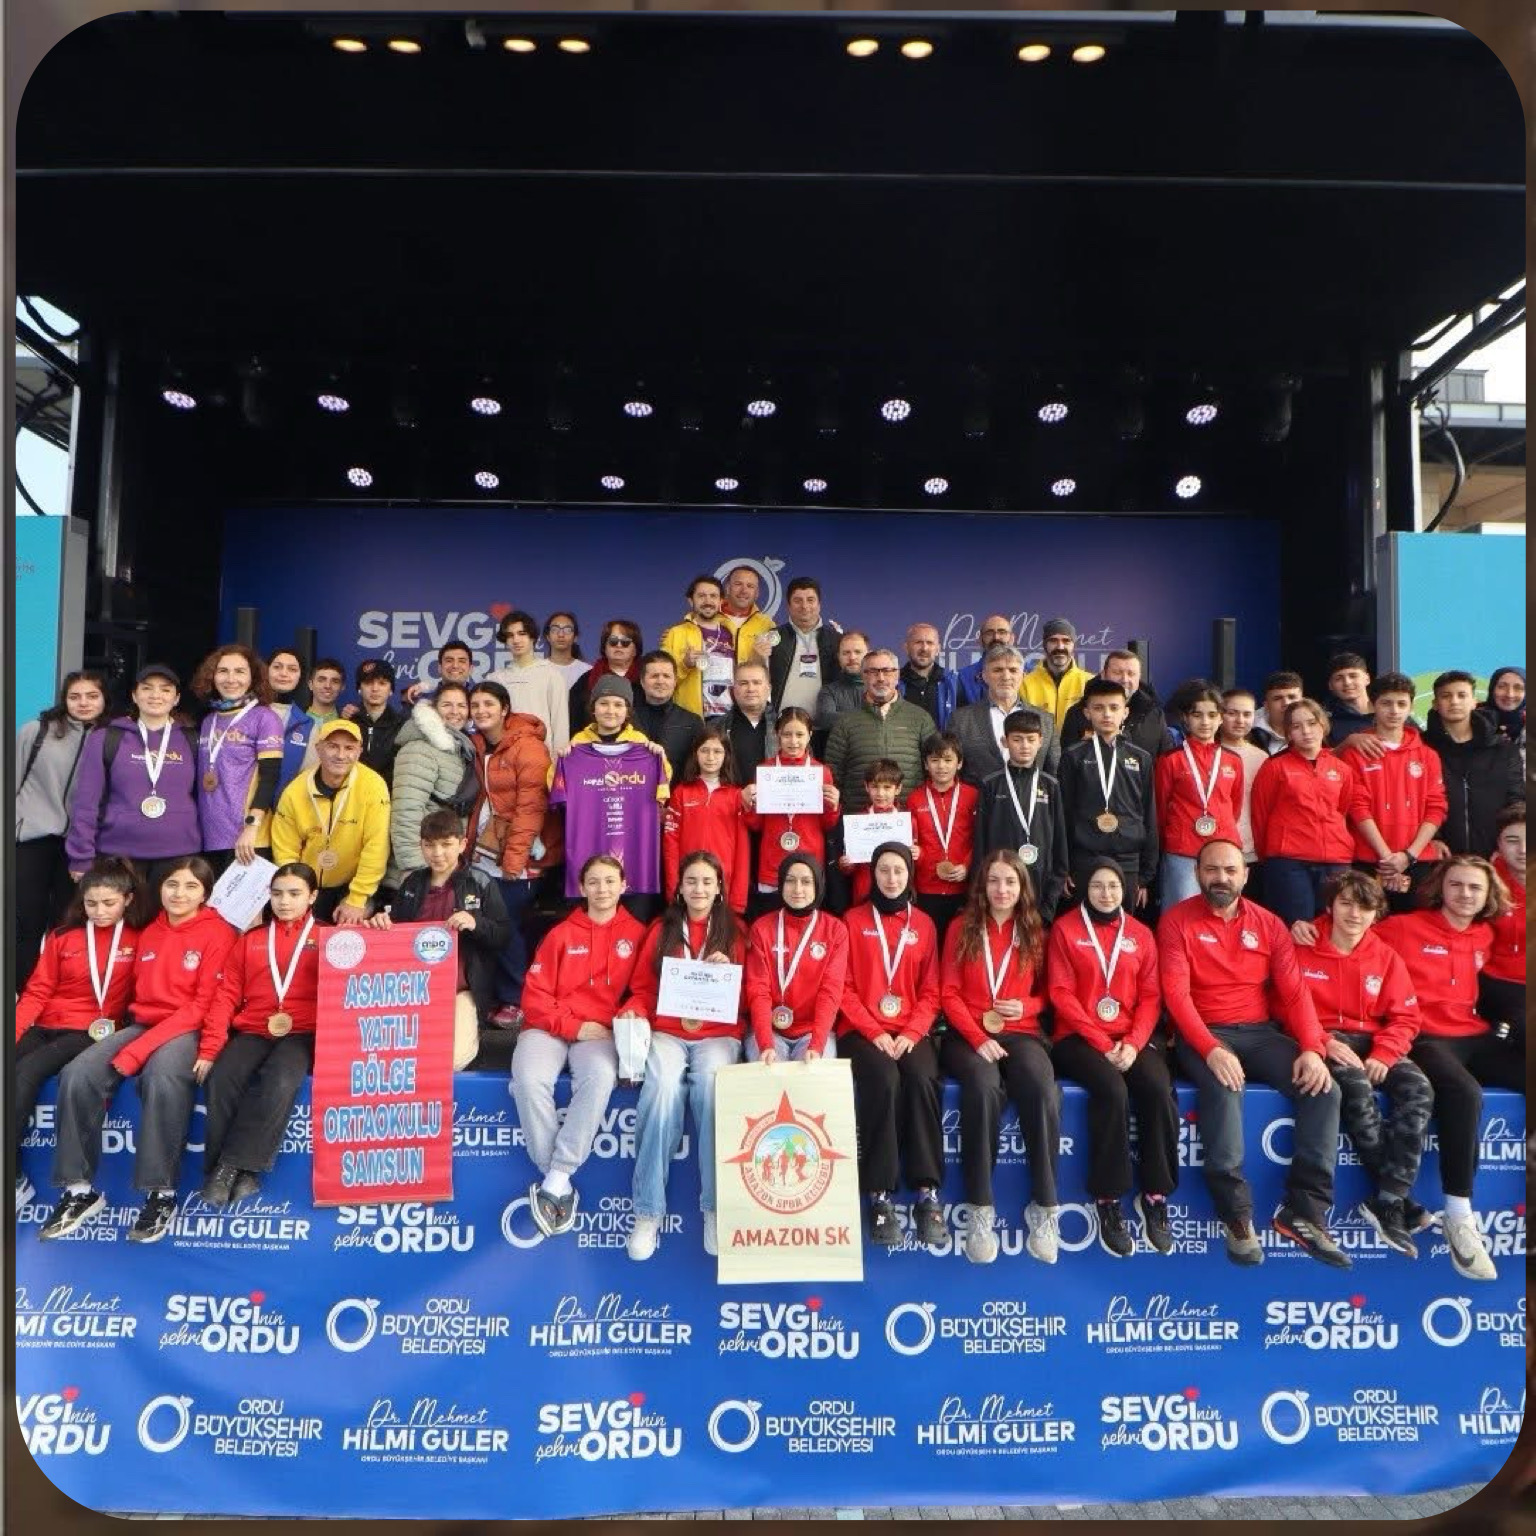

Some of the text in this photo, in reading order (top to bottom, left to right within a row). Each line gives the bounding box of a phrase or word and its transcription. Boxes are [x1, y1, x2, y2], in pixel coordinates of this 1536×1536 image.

[344, 970, 431, 1009] ASARCIK
[358, 1013, 419, 1052] YATILI
[351, 1053, 417, 1097] BÖLGE
[323, 1099, 442, 1143] ORTAOKULU
[341, 1148, 425, 1188] SAMSUN
[599, 1196, 635, 1212] ORD
[229, 1218, 311, 1241] GÜLER
[374, 1225, 476, 1253] ORDU
[731, 1226, 851, 1248] AMAZON SK
[1328, 1230, 1390, 1249] GÜLE
[42, 1285, 122, 1313] Mehmet
[426, 1298, 471, 1315] ORDU
[554, 1291, 672, 1326] Dr. Mehmet
[982, 1301, 1027, 1317] ORDU
[1107, 1293, 1219, 1322] Dr. Mehmet
[52, 1315, 137, 1339] GÜLER
[158, 1323, 300, 1354] şehri ORDU
[381, 1314, 510, 1340] BÜYÜKŞEHİR
[529, 1321, 692, 1348] HİLMİ GÜLER
[940, 1315, 1067, 1338] BÜYÜKŞEHİR
[1087, 1319, 1240, 1344] HİLMİ GÜLER
[1264, 1323, 1399, 1352] şehri ORDU
[401, 1337, 486, 1355] BELEDİYESİ
[718, 1330, 860, 1360] şehri ORDU
[964, 1337, 1046, 1354] BELEDİYESİ
[238, 1399, 285, 1416] ORDU
[809, 1400, 855, 1416] ORDU
[939, 1393, 1055, 1426] Dr. Mehmet
[1353, 1389, 1399, 1404] ORDU
[366, 1397, 489, 1429] Dr. Mehmet
[1314, 1403, 1440, 1427] BÜYÜKŞEHİR
[193, 1415, 324, 1442] BÜYÜKŞEHİR
[342, 1427, 510, 1453] HİLMİ GÜLER
[765, 1415, 896, 1439] BÜYÜKŞEHİR
[916, 1420, 1076, 1446] HİLMİ GÜLER
[1101, 1421, 1239, 1452] şehri ORDU
[1337, 1425, 1420, 1443] BELEDİYESİ
[214, 1437, 299, 1458] BELEDİYESİ
[535, 1427, 683, 1464] şehri ORDU
[788, 1437, 874, 1454] BELEDİYESİ
